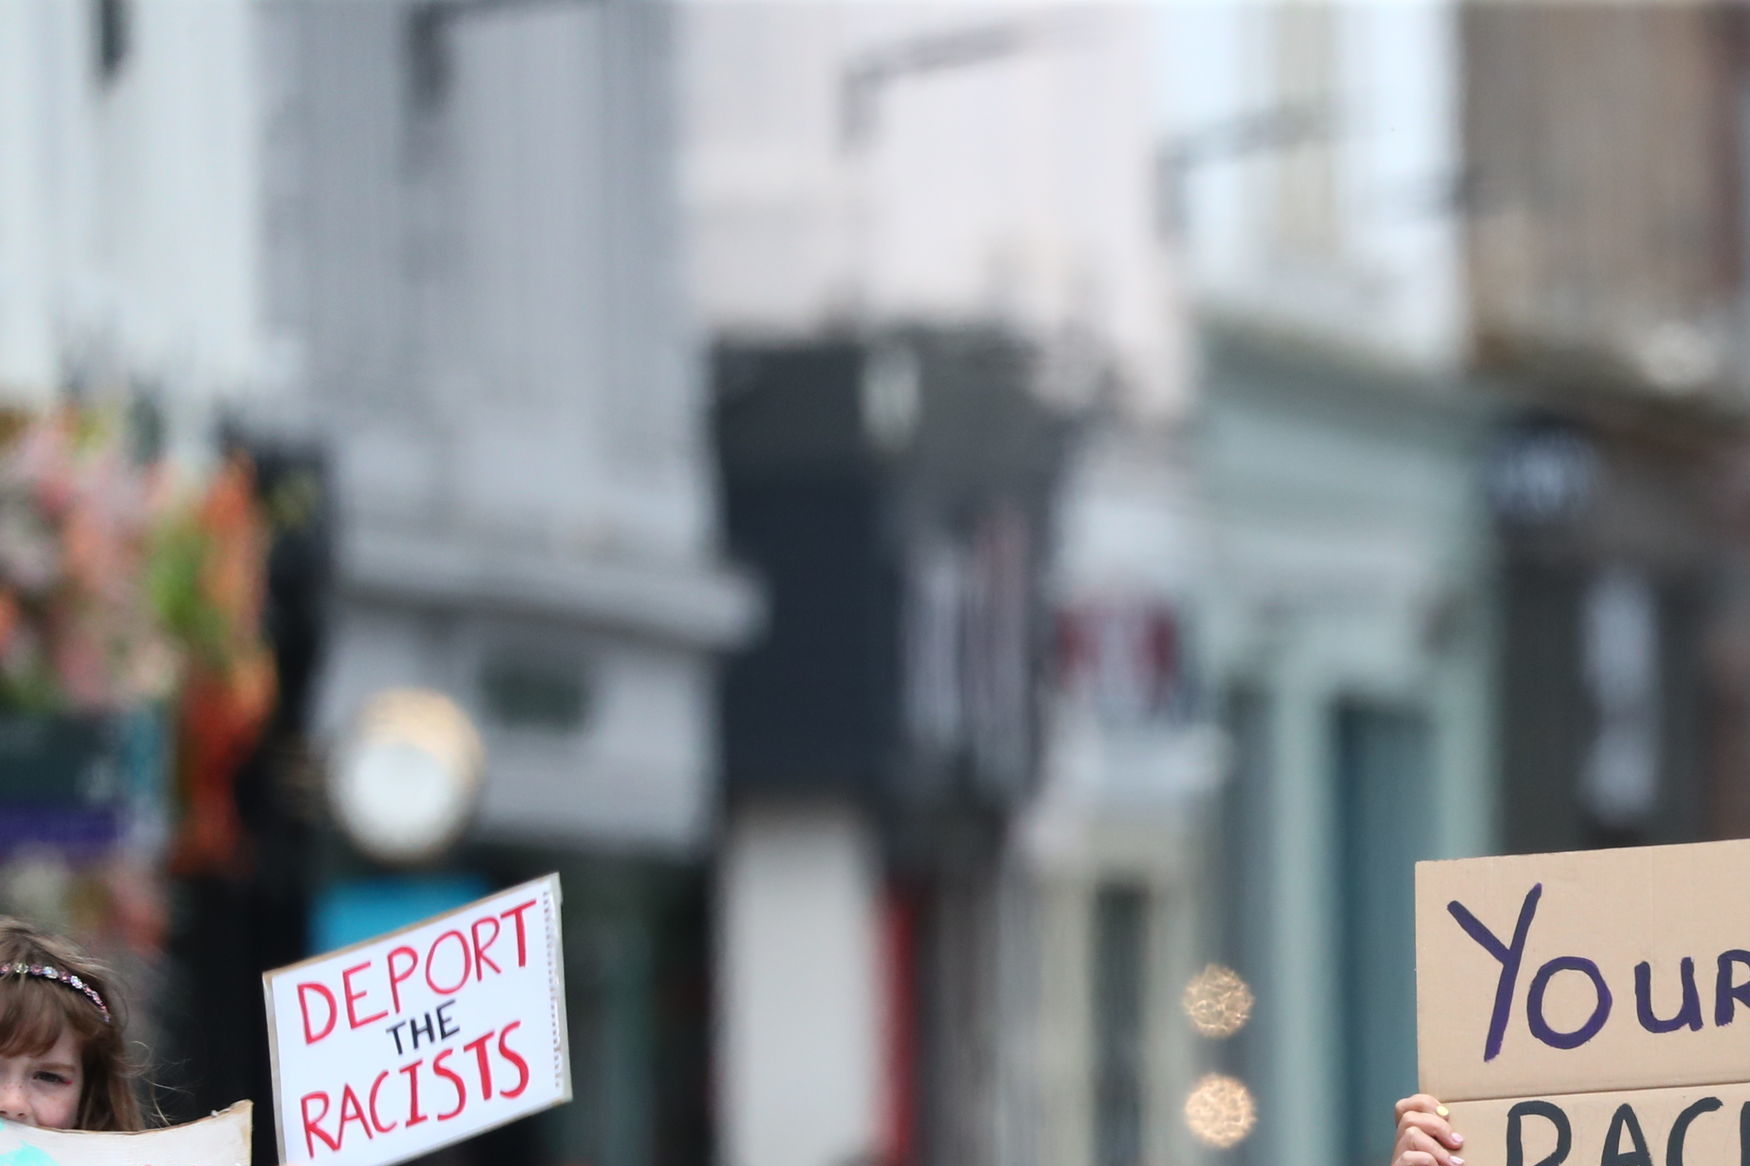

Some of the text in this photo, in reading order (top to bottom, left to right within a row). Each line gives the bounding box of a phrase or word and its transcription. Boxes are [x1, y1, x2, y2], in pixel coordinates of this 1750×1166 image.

[297, 900, 537, 1045] DEPORT
[386, 999, 461, 1056] THE
[300, 1020, 530, 1159] RACISTS
